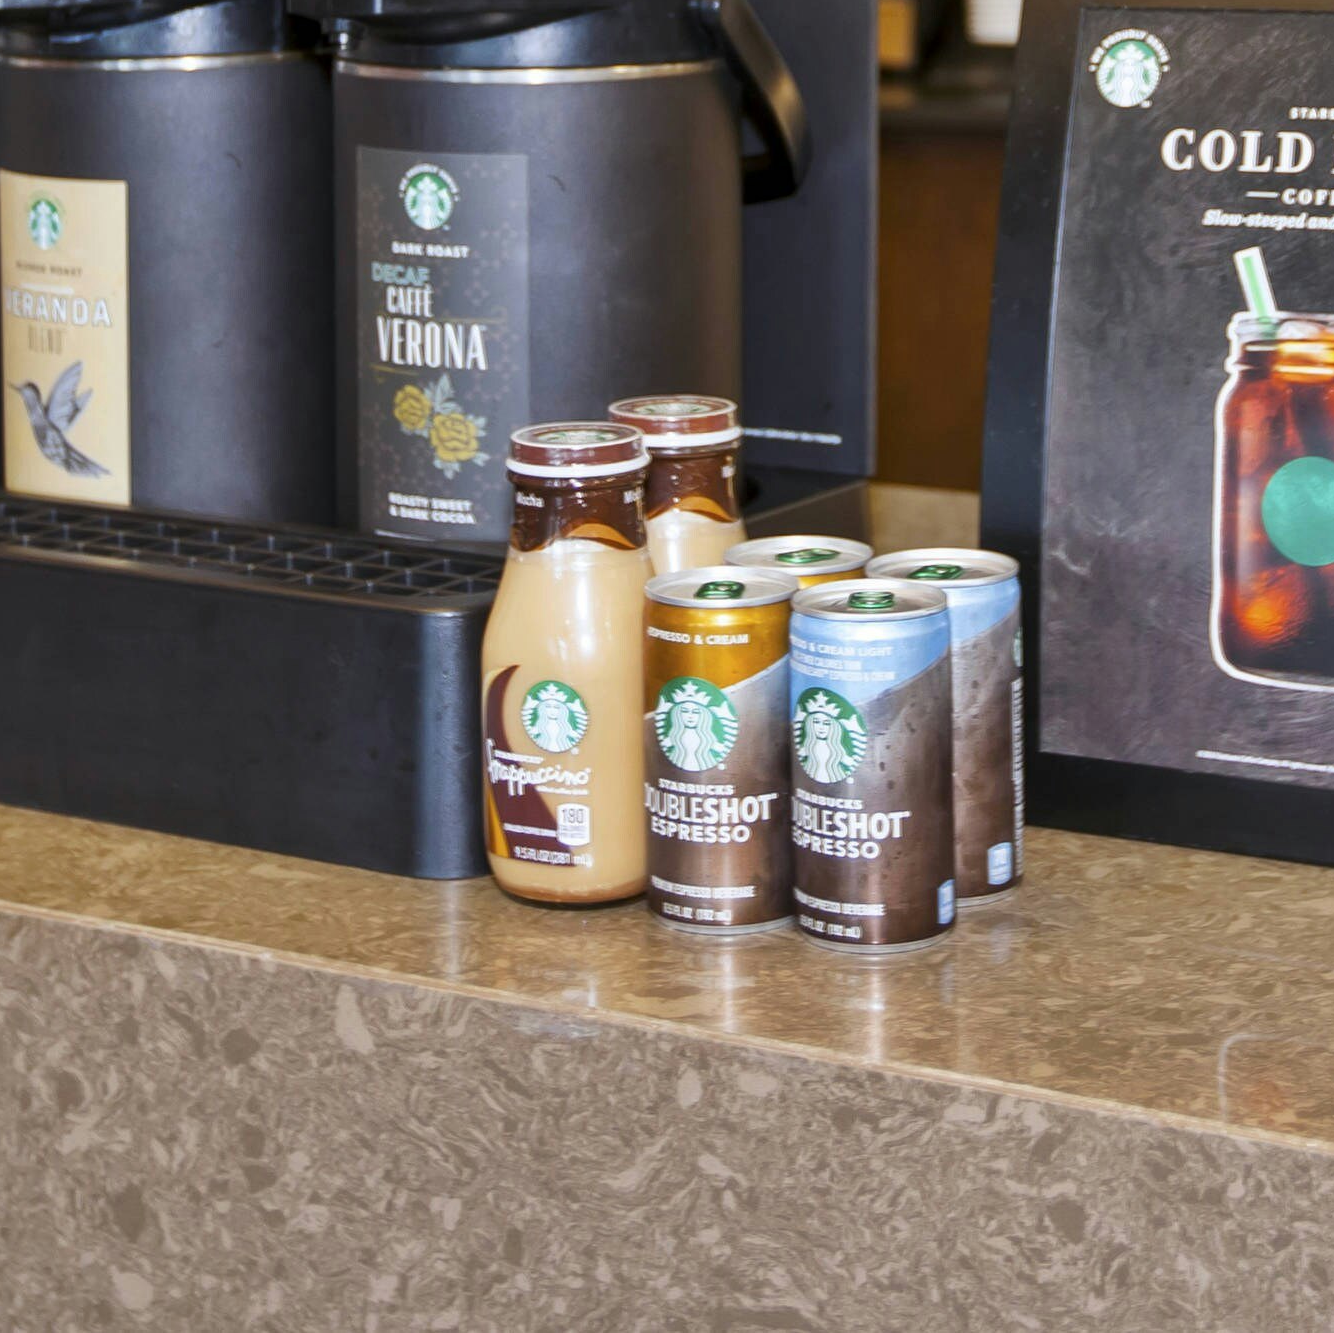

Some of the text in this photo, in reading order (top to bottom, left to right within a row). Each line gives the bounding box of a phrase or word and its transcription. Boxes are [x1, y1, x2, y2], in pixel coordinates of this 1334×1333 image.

[1160, 128, 1315, 174] COLD
[1202, 208, 1307, 231] Slow-steeped
[391, 241, 470, 258] DARK ROAST
[371, 261, 431, 287] DECAF
[376, 315, 488, 371] VERONA
[431, 510, 477, 525] COCOA
[693, 634, 704, 645] &
[706, 633, 749, 645] CREAM
[817, 644, 854, 656] CREAM
[858, 646, 893, 657] LIGHT
[659, 778, 735, 795] STARBUCKS
[796, 788, 863, 810] STARBUCKS
[651, 816, 751, 843] ESPRESSO
